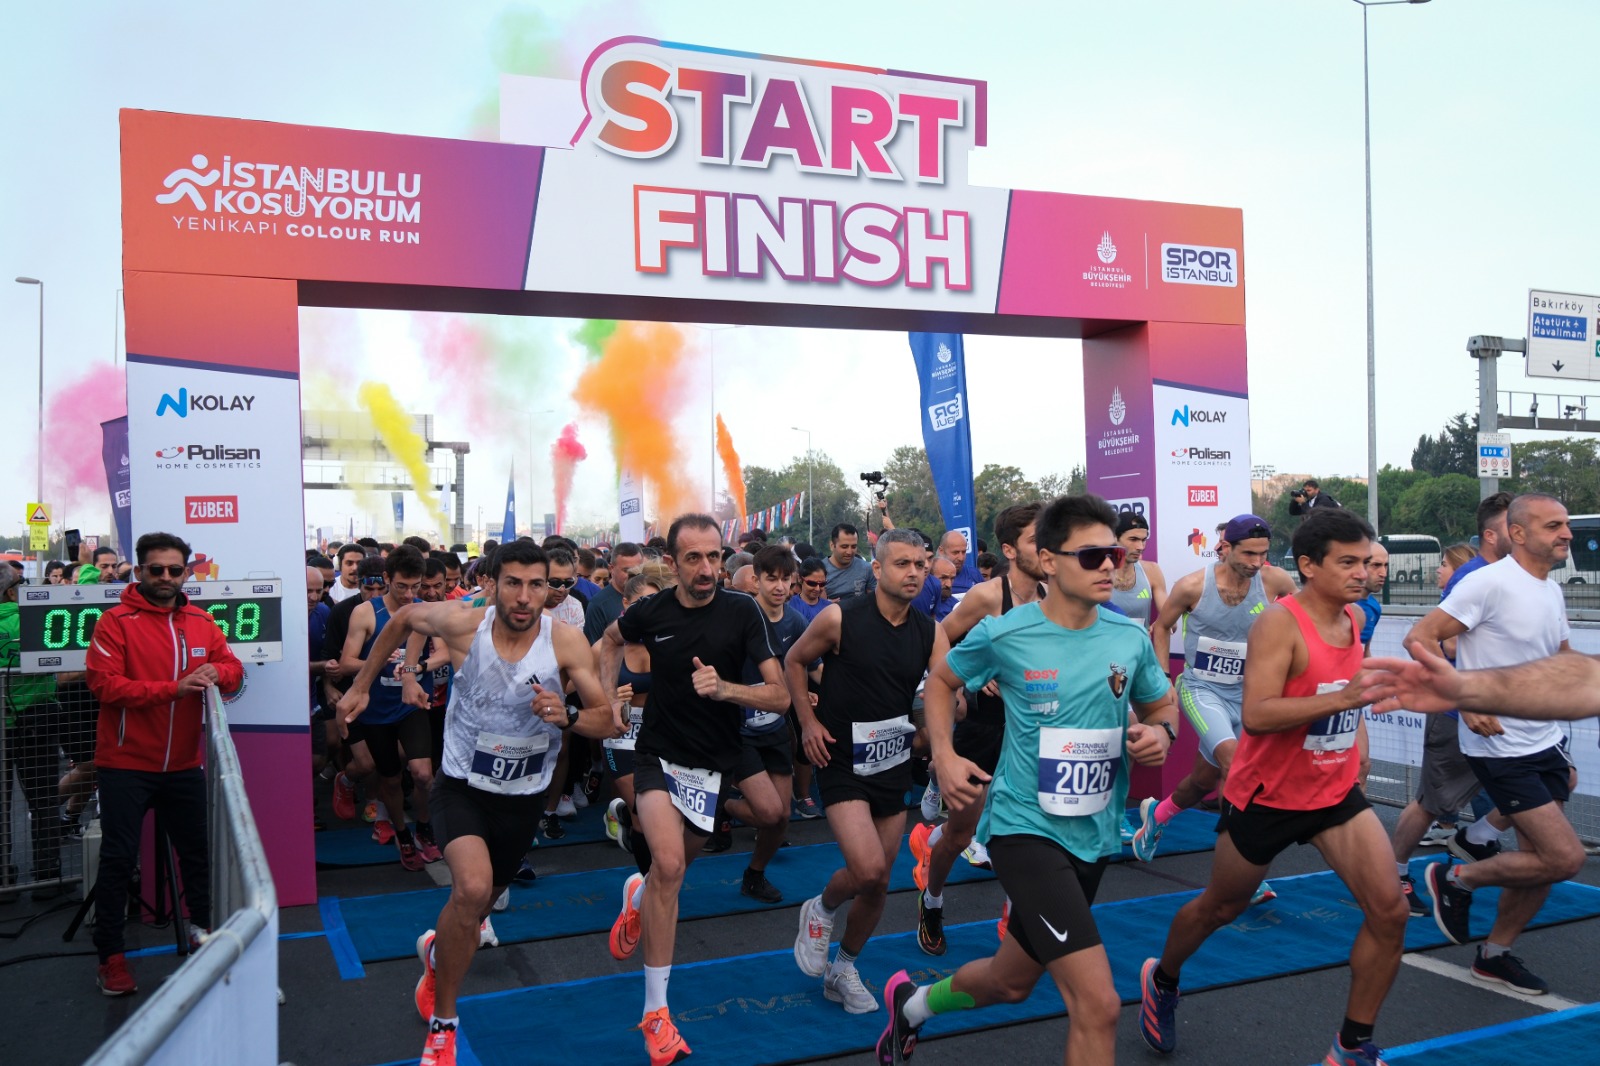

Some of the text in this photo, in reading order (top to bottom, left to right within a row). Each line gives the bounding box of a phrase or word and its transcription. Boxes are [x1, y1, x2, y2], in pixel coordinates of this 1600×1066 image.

[595, 57, 964, 183] START
[222, 155, 421, 199] İSTANBULU
[172, 216, 421, 245] YENİKAPI COLOUR RUN
[633, 184, 970, 292] FINISH
[1166, 247, 1232, 271] SPOR
[1533, 297, 1583, 313] Bakırköy
[1534, 316, 1571, 329] Atatürk
[1533, 325, 1586, 340] Havalimanı
[190, 395, 255, 411] KOLAY
[1190, 411, 1227, 423] KOLAY
[187, 445, 260, 460] Polisan
[1189, 447, 1231, 460] Polisan
[1190, 490, 1216, 502] ZÜBER
[189, 501, 234, 518] ZÜBER
[1207, 654, 1243, 675] 1459
[1024, 669, 1059, 682] KOSY
[1397, 715, 1422, 729] RUN
[865, 735, 906, 763] 2098
[491, 757, 529, 780] 971
[1055, 761, 1112, 795] 2026
